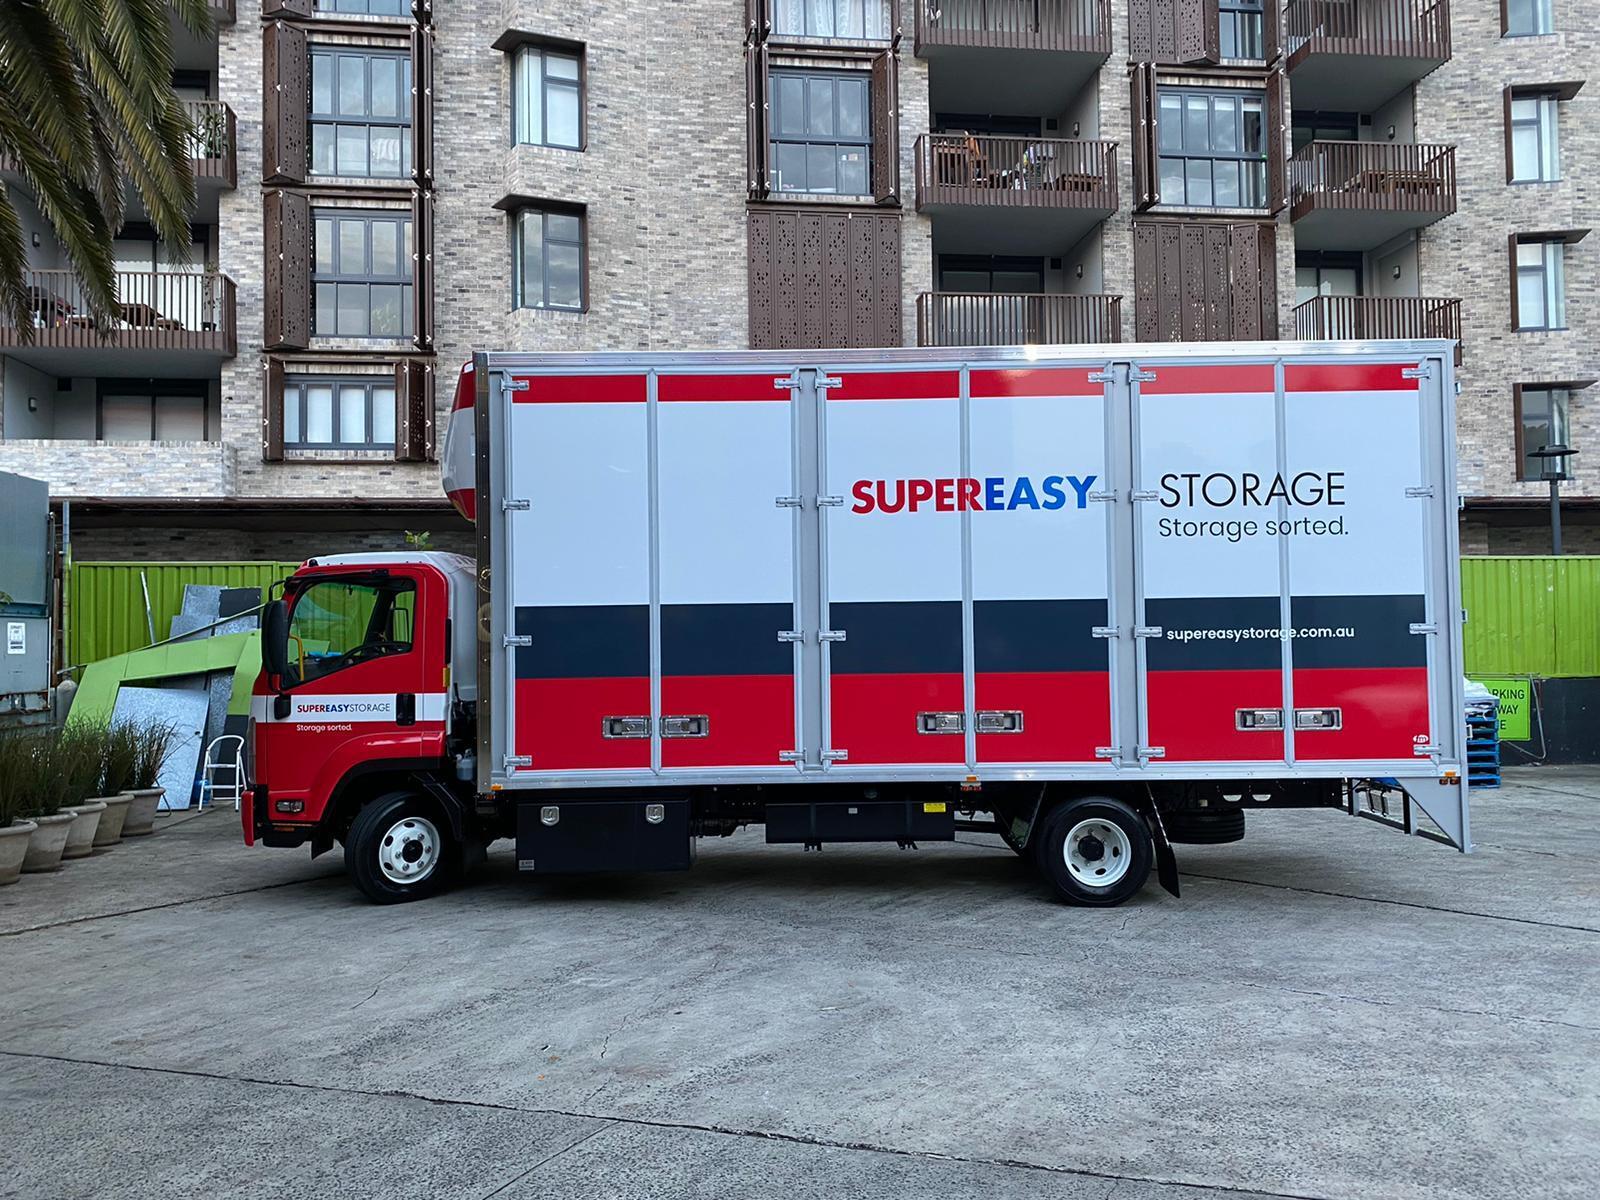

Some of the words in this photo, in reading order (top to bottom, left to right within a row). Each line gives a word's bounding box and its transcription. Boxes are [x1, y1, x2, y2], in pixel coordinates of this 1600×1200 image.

[851, 475, 1098, 514] SUPEREASY
[1159, 471, 1346, 508] STORAGE
[1158, 517, 1258, 543] Storage
[1265, 515, 1349, 537] sorted.
[1166, 626, 1355, 643] supereasystorage.com.au
[297, 703, 390, 713] SUPEREASYSTORAGE
[296, 724, 326, 733] Storage
